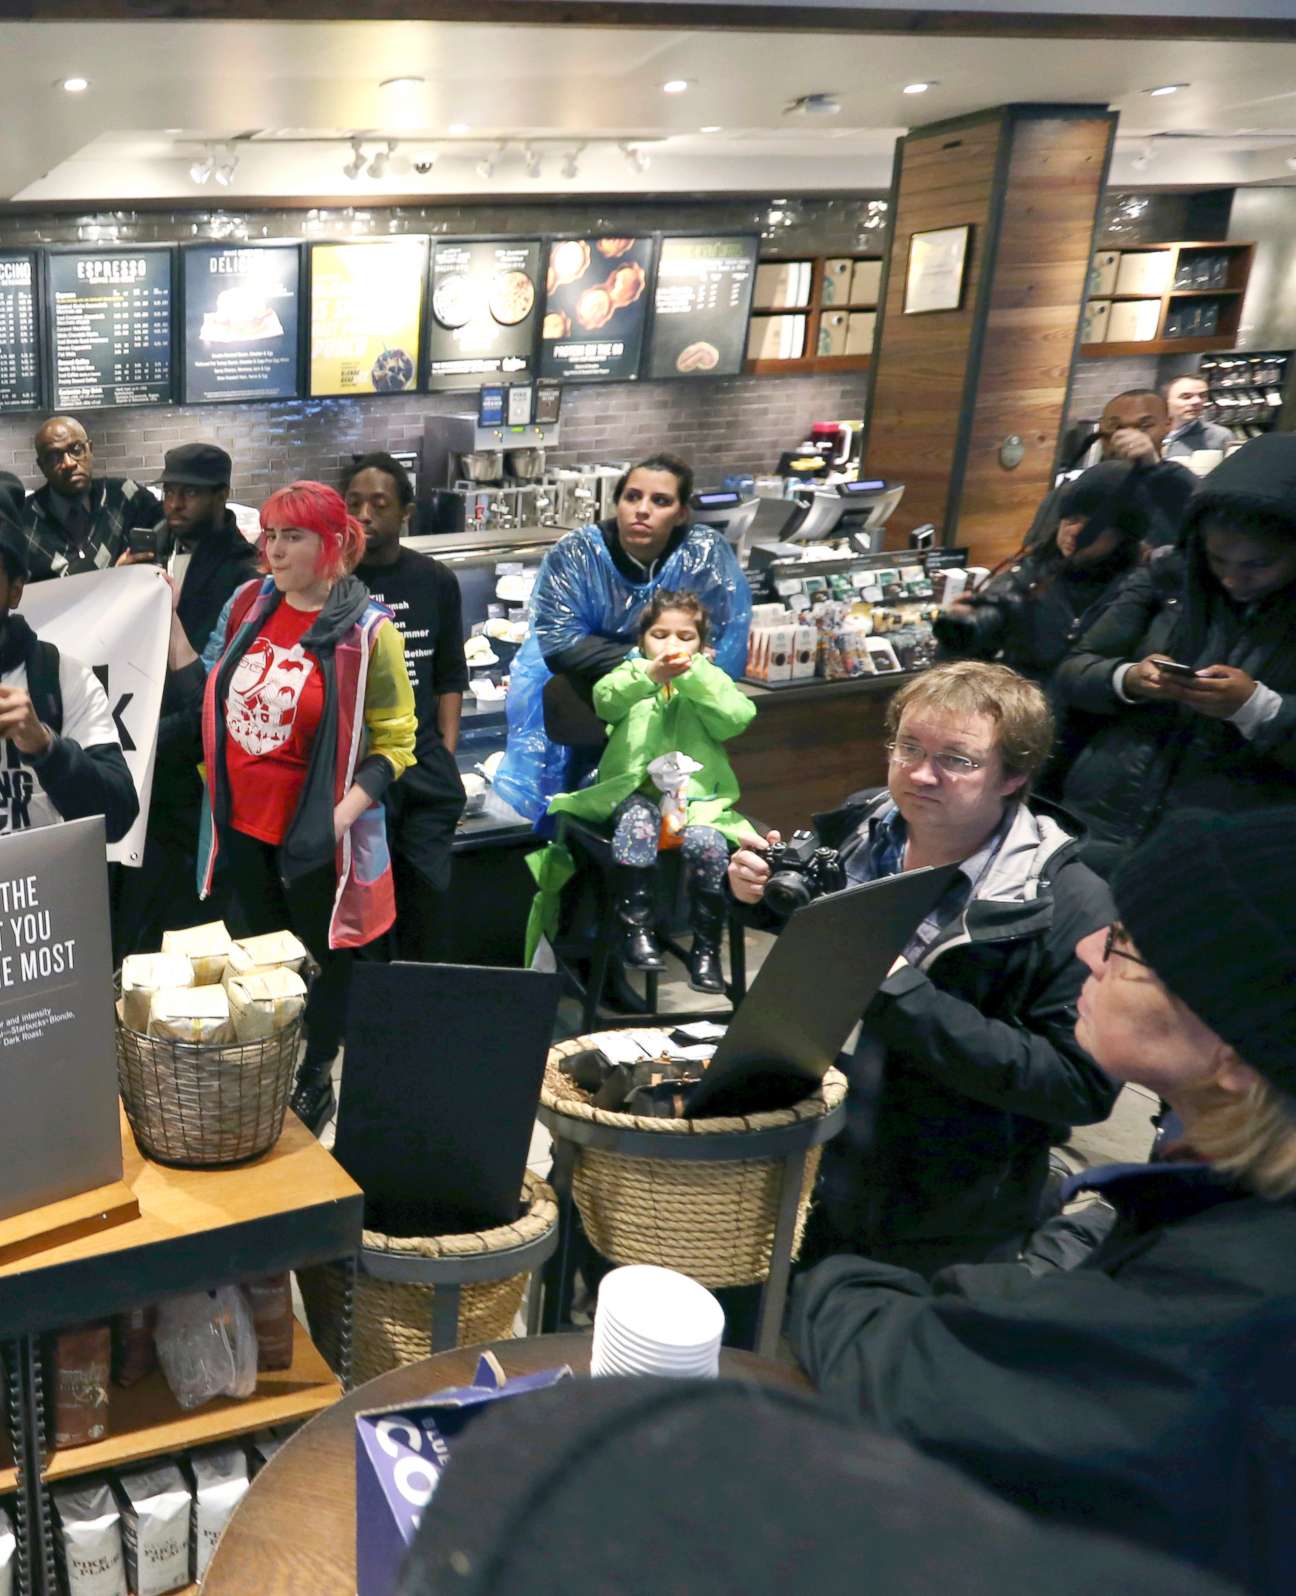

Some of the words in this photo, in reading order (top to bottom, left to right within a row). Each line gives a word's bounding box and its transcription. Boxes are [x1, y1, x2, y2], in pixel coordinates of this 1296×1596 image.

[77, 260, 146, 278] ESPRESSO
[0, 875, 39, 912] THE
[10, 910, 52, 947] YOU
[20, 940, 76, 982] MOST
[6, 1016, 20, 1026] and
[22, 1008, 52, 1022] intensity
[3, 1036, 20, 1047] Dark
